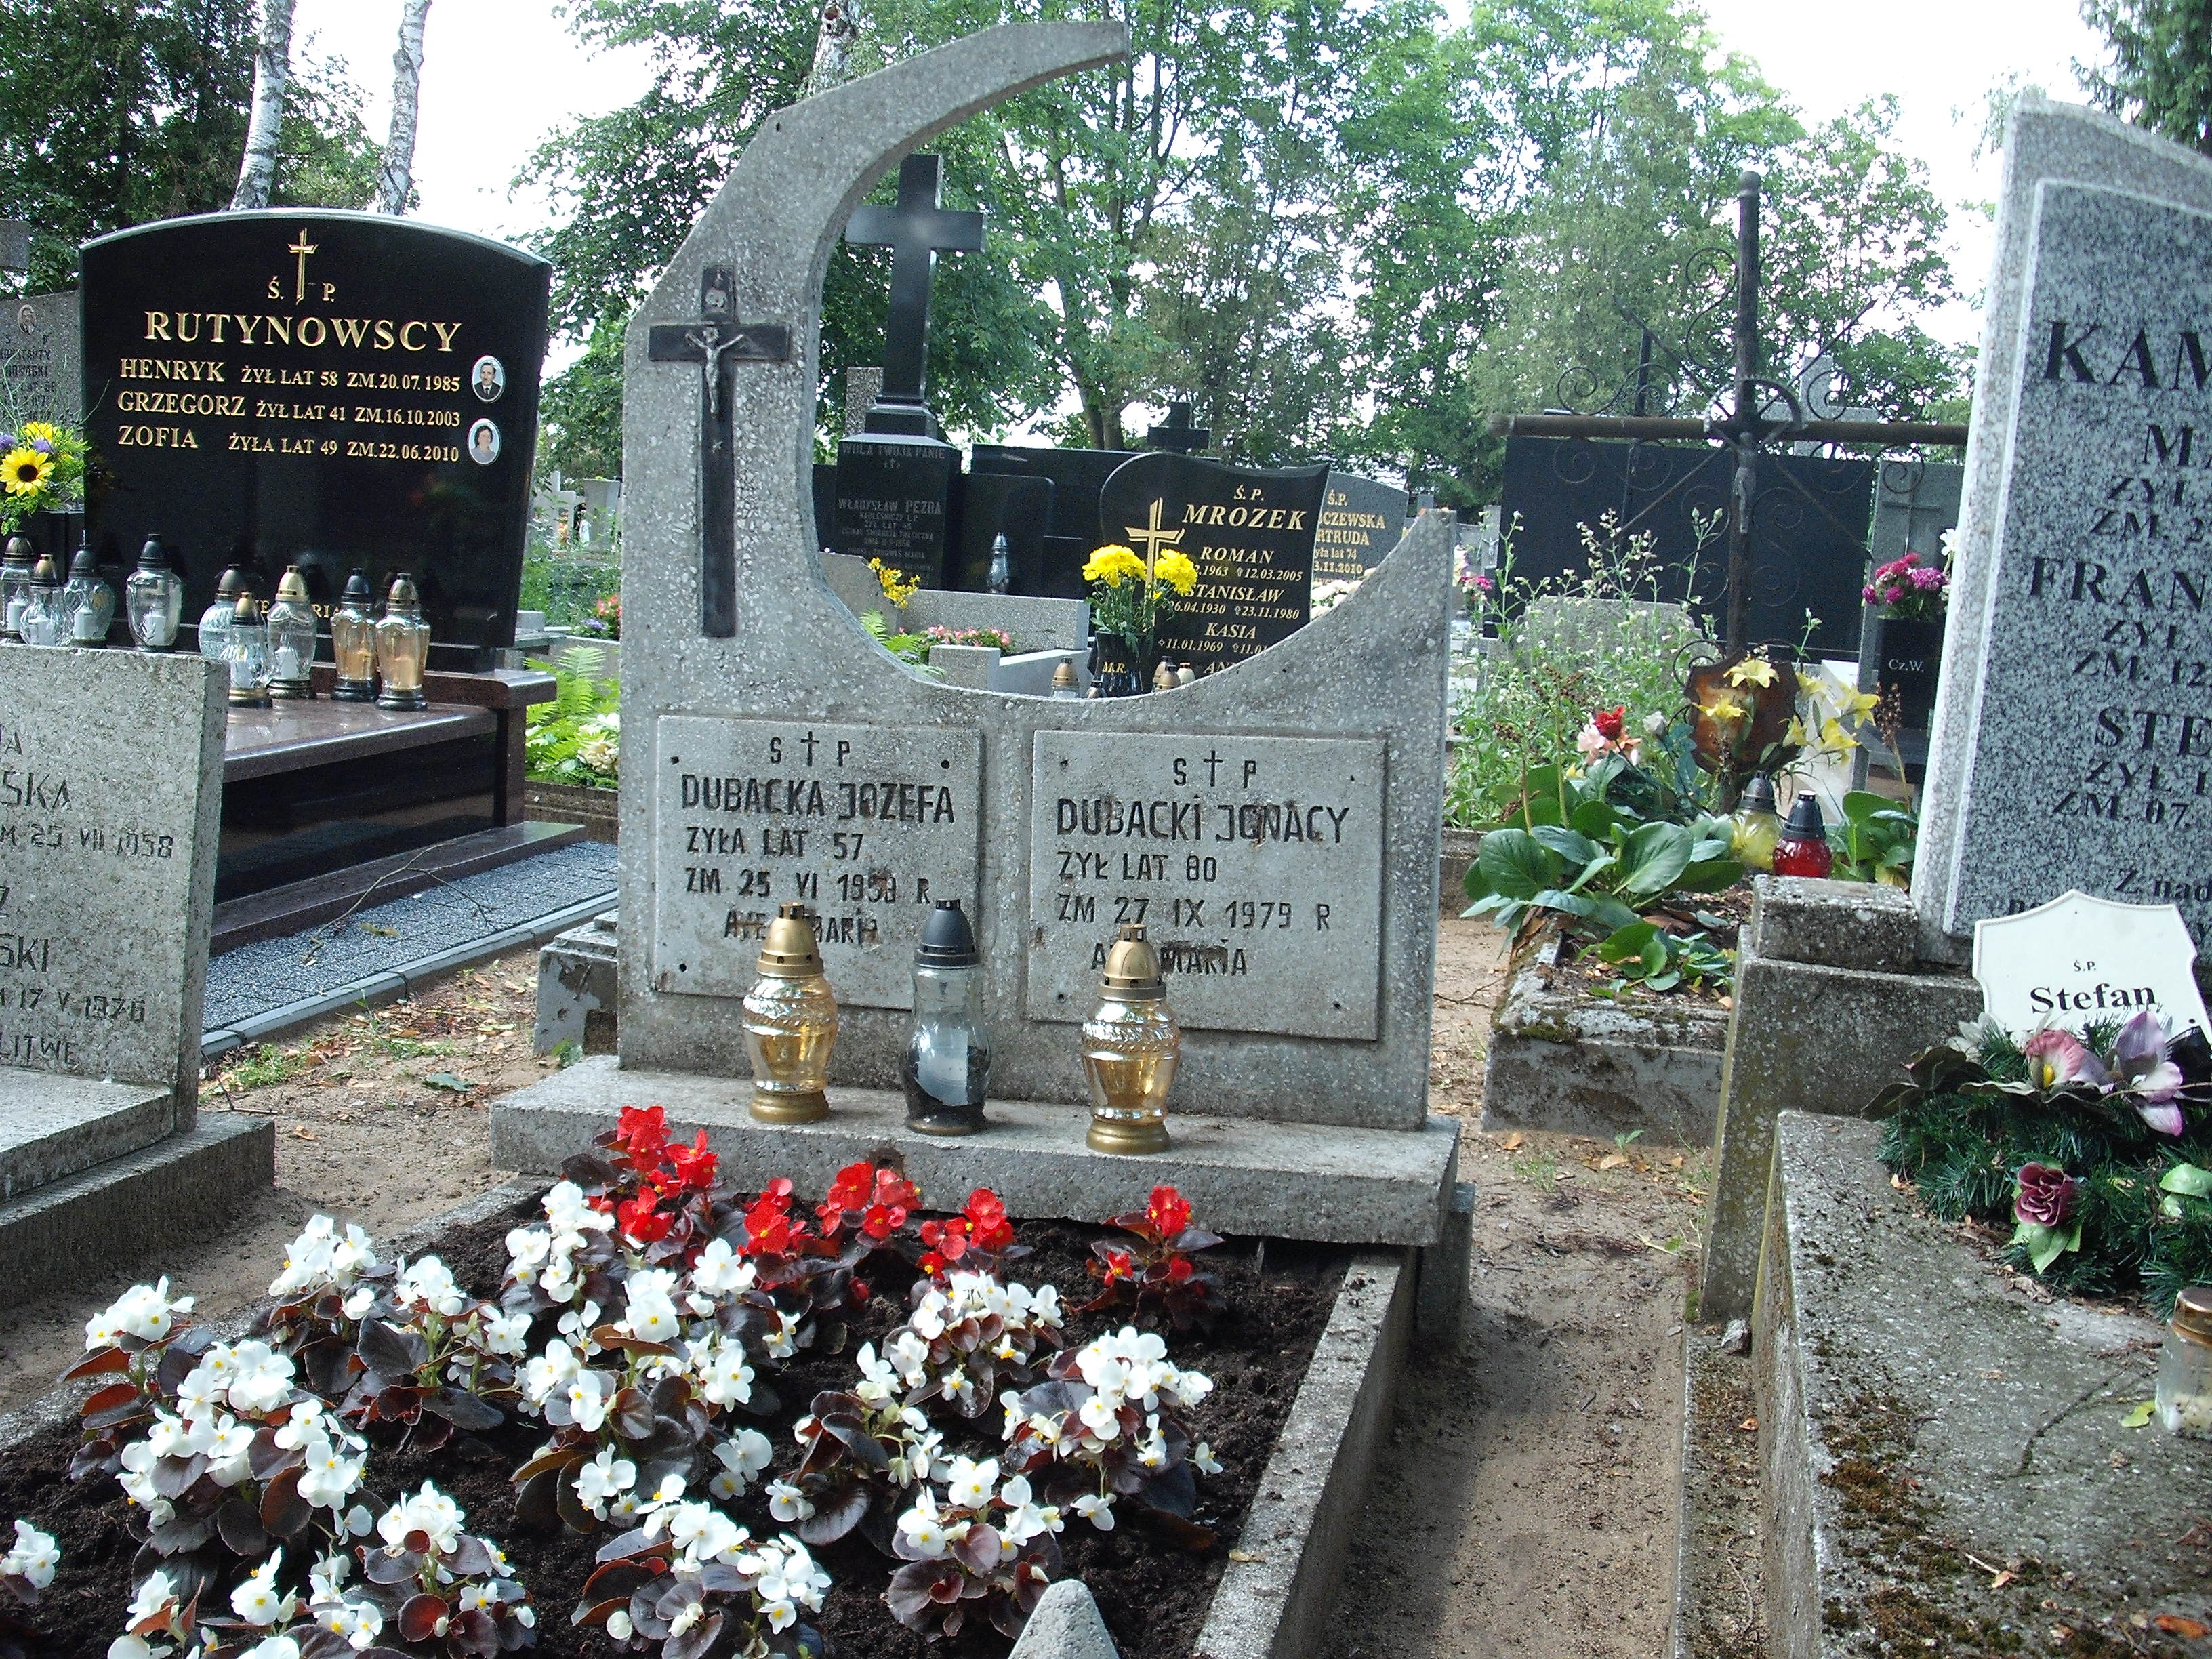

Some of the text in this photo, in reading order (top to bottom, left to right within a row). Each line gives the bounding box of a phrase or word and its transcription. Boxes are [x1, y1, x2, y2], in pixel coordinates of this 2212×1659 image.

[268, 275, 335, 302] Ś. P.
[144, 310, 462, 352] RUTYNOWSCY
[120, 357, 225, 382] HENRYK
[241, 365, 276, 384] ŻYŁ
[280, 369, 314, 386] LAT
[320, 371, 338, 387] 58
[117, 390, 246, 417] GRZEGORZ
[255, 399, 289, 418] ŻYŁ
[292, 404, 325, 420] LAT
[329, 405, 345, 422] 41
[118, 426, 199, 449] ZOFIA
[228, 432, 274, 453] ŻYŁA
[281, 438, 314, 454] LAT
[320, 440, 338, 455] 49
[1181, 504, 1308, 531] MROZEK
[1200, 546, 1275, 565] ROMAN
[1331, 547, 1345, 559] lat
[1195, 564, 1229, 577] 2.1963
[1244, 567, 1304, 582] 12.03.2005
[1187, 583, 1285, 603] STANISŁAW
[1242, 605, 1300, 620] 23.11.1980
[1166, 638, 1224, 652] 11.01.1969
[1204, 623, 1257, 639] KASIA
[838, 741, 851, 767] P
[1173, 758, 1257, 789] S P
[681, 774, 825, 817] DUBACKA
[1057, 795, 1202, 842] DUBACKI
[762, 829, 809, 857] LAT
[834, 832, 863, 861] 57
[1186, 855, 1217, 882] 80
[685, 867, 720, 894] ZM
[739, 869, 771, 897] 25
[796, 872, 818, 899] VI
[917, 878, 930, 904] R
[1057, 893, 1330, 931] ZM 27 IX 1979 R
[2029, 983, 2158, 1015] Stefan
